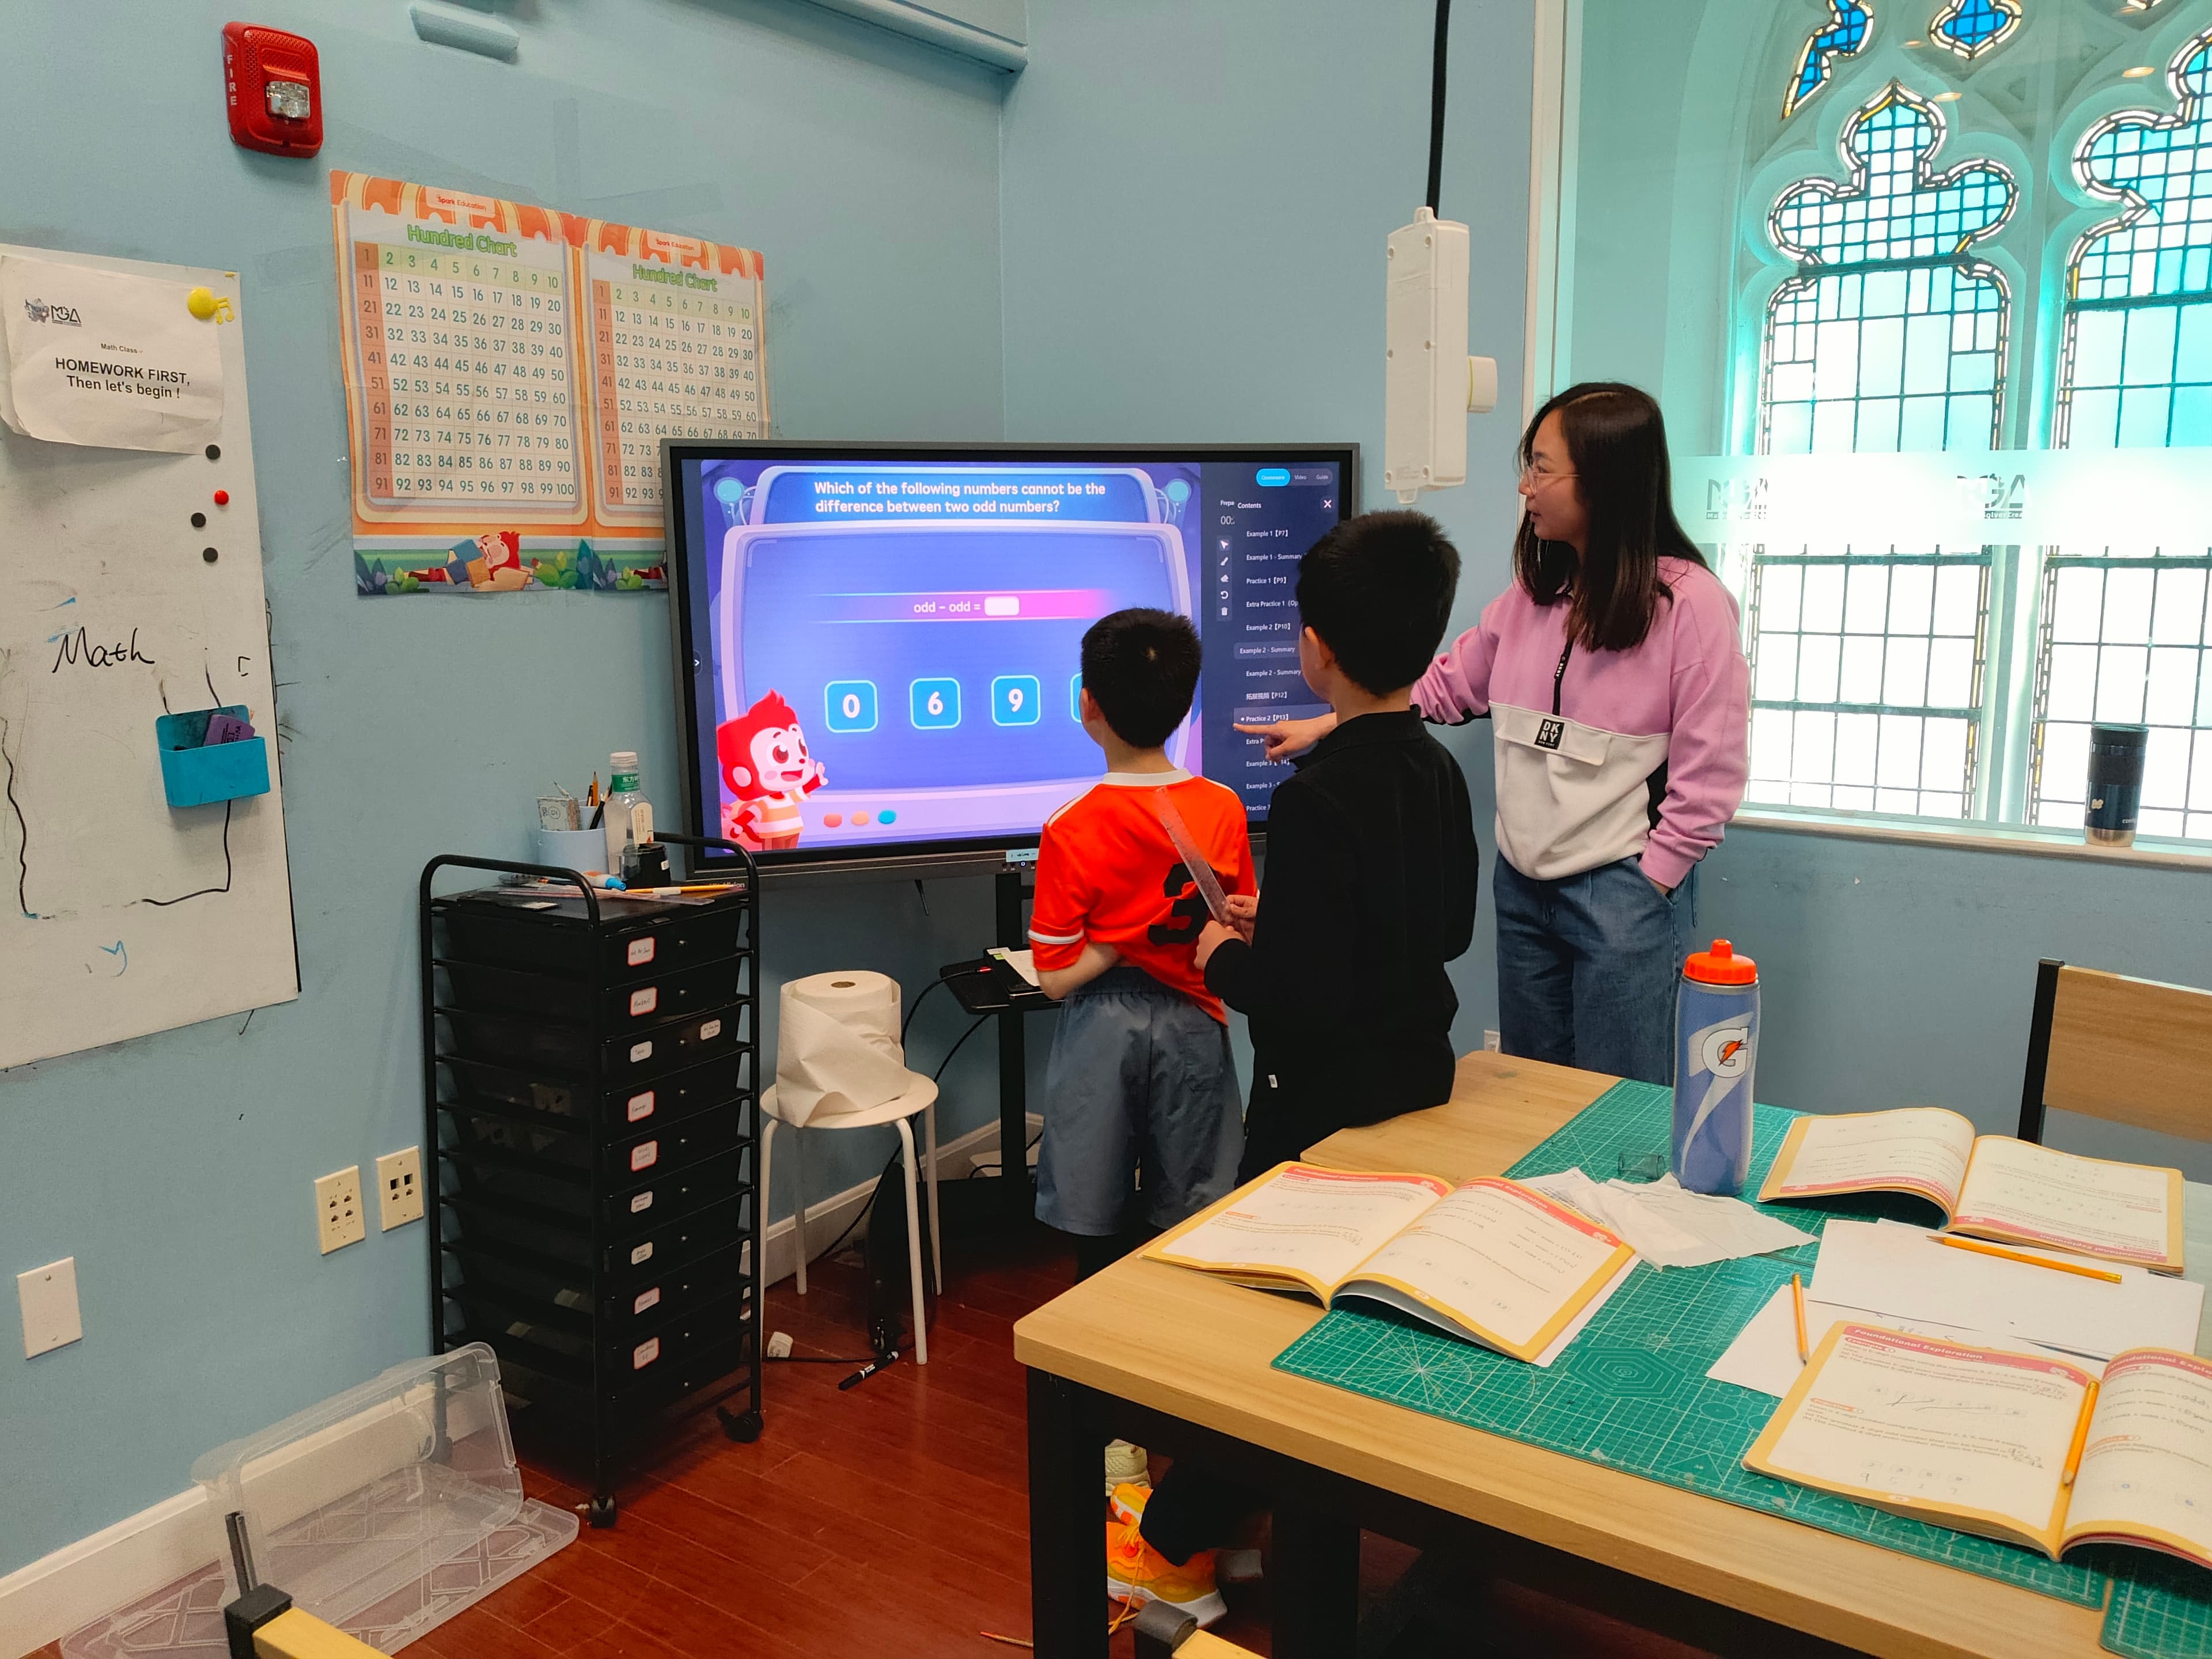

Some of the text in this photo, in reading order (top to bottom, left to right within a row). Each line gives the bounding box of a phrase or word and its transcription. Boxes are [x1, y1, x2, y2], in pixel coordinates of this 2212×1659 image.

[228, 55, 237, 105] FIRE
[438, 195, 486, 210] Spark Education
[408, 225, 517, 256] Hundred Chart
[656, 238, 670, 247] Spark
[365, 249, 558, 288] 1 2 3 4 5 6 7 8 9 10
[633, 264, 717, 291] Hundred Chart
[600, 309, 752, 339] 11 12 13 14 15 16 17 18 19 20
[101, 343, 138, 354] Math Class
[55, 357, 190, 386] HOMEWORK FIRST,
[67, 376, 101, 390] Then
[106, 380, 132, 393] let's
[137, 383, 172, 399] begin
[372, 377, 565, 404] 51 52 53 54 55 56 57 58 59 60
[376, 478, 574, 494] 91 92 93 94 95 96 97 98 99 100
[815, 482, 1105, 497] Which of the following numbers cannot be the
[816, 500, 1059, 512] difference between two odd numbers?
[914, 601, 935, 613] odd
[949, 601, 970, 612] odd
[53, 627, 155, 673] Math
[843, 689, 1023, 718] 0 6 9
[1540, 730, 1558, 743] NY
[1543, 721, 1560, 733] DK
[1854, 1329, 1983, 1359] Foundational Exploration
